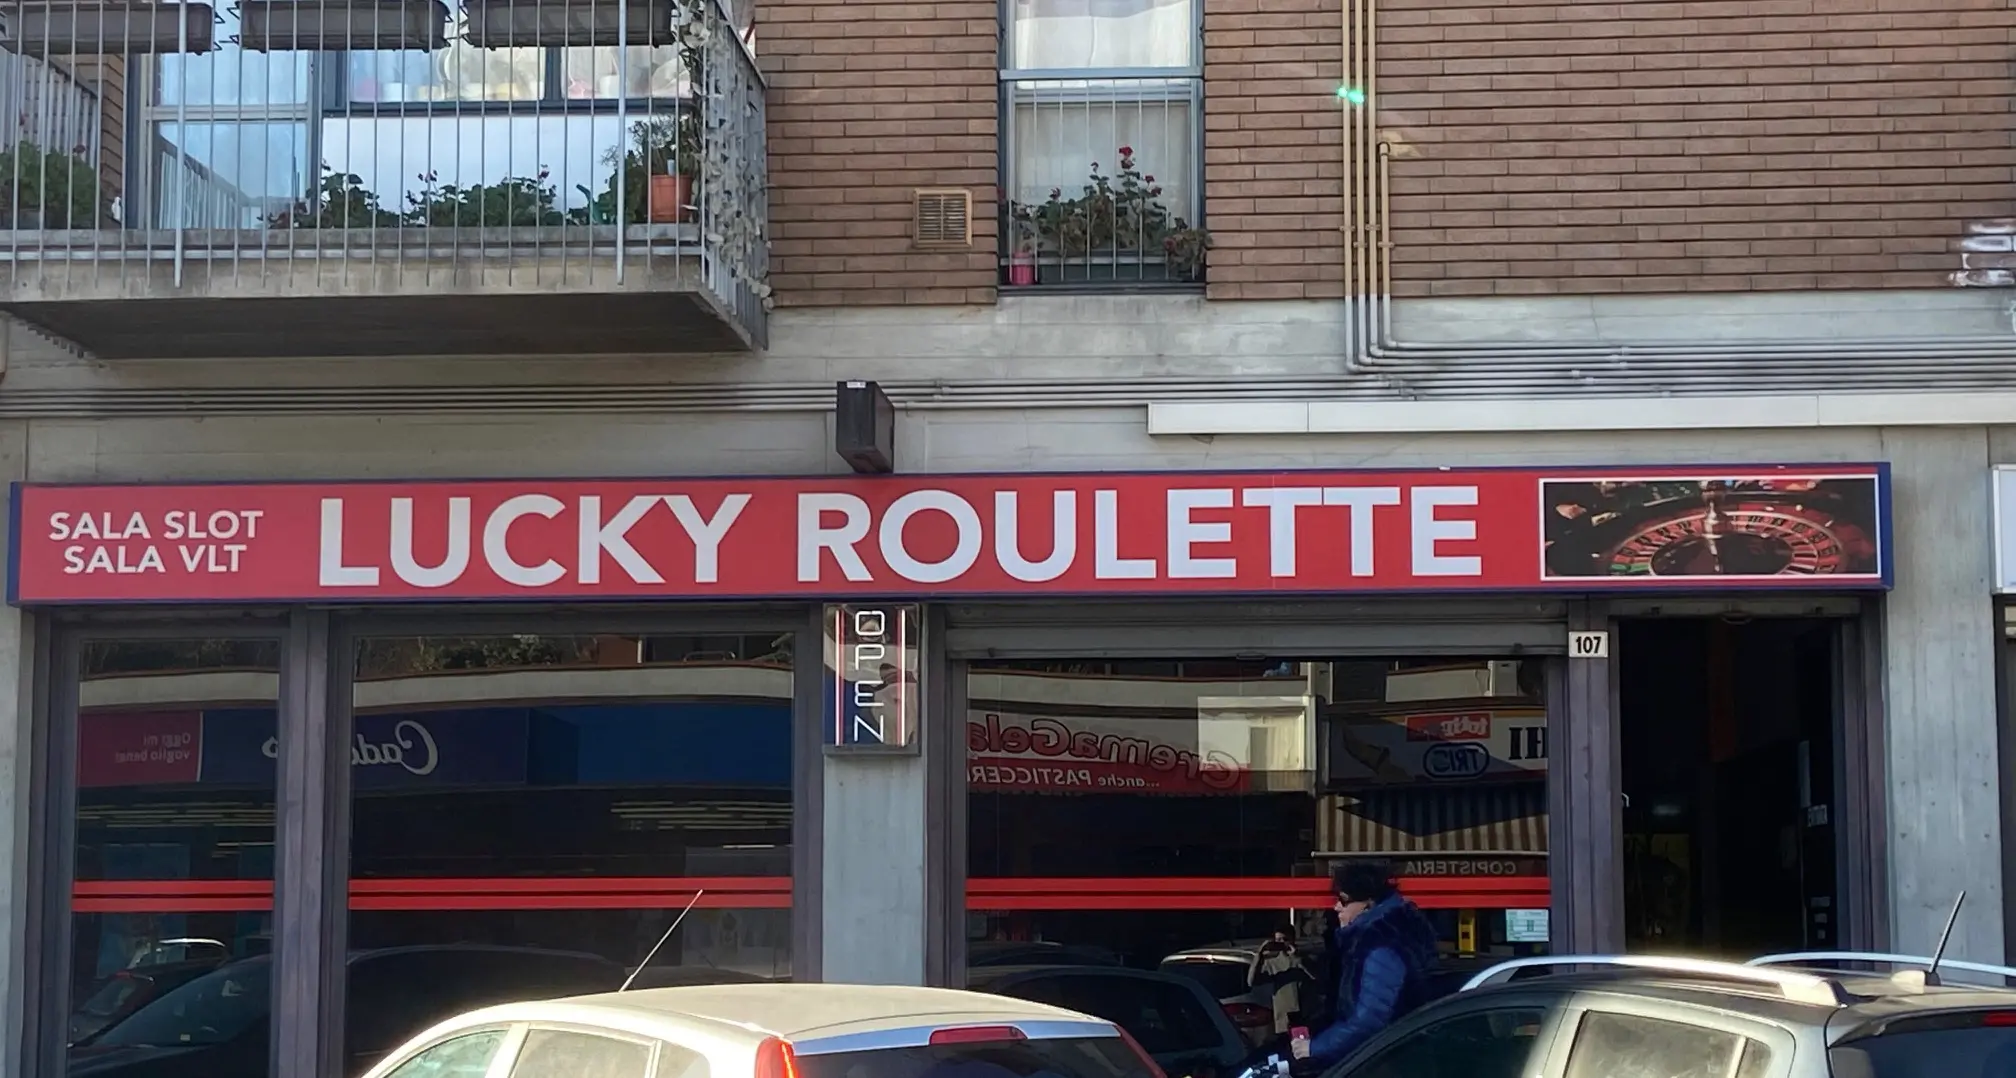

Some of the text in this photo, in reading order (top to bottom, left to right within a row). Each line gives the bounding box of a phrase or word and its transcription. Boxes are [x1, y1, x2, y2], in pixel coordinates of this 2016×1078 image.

[49, 509, 264, 540] SALA SLOT
[319, 485, 1483, 588] LUCKY ROULETTE
[63, 544, 247, 574] SALA VLT
[1575, 636, 1602, 654] 107
[853, 610, 886, 743] OPEN
